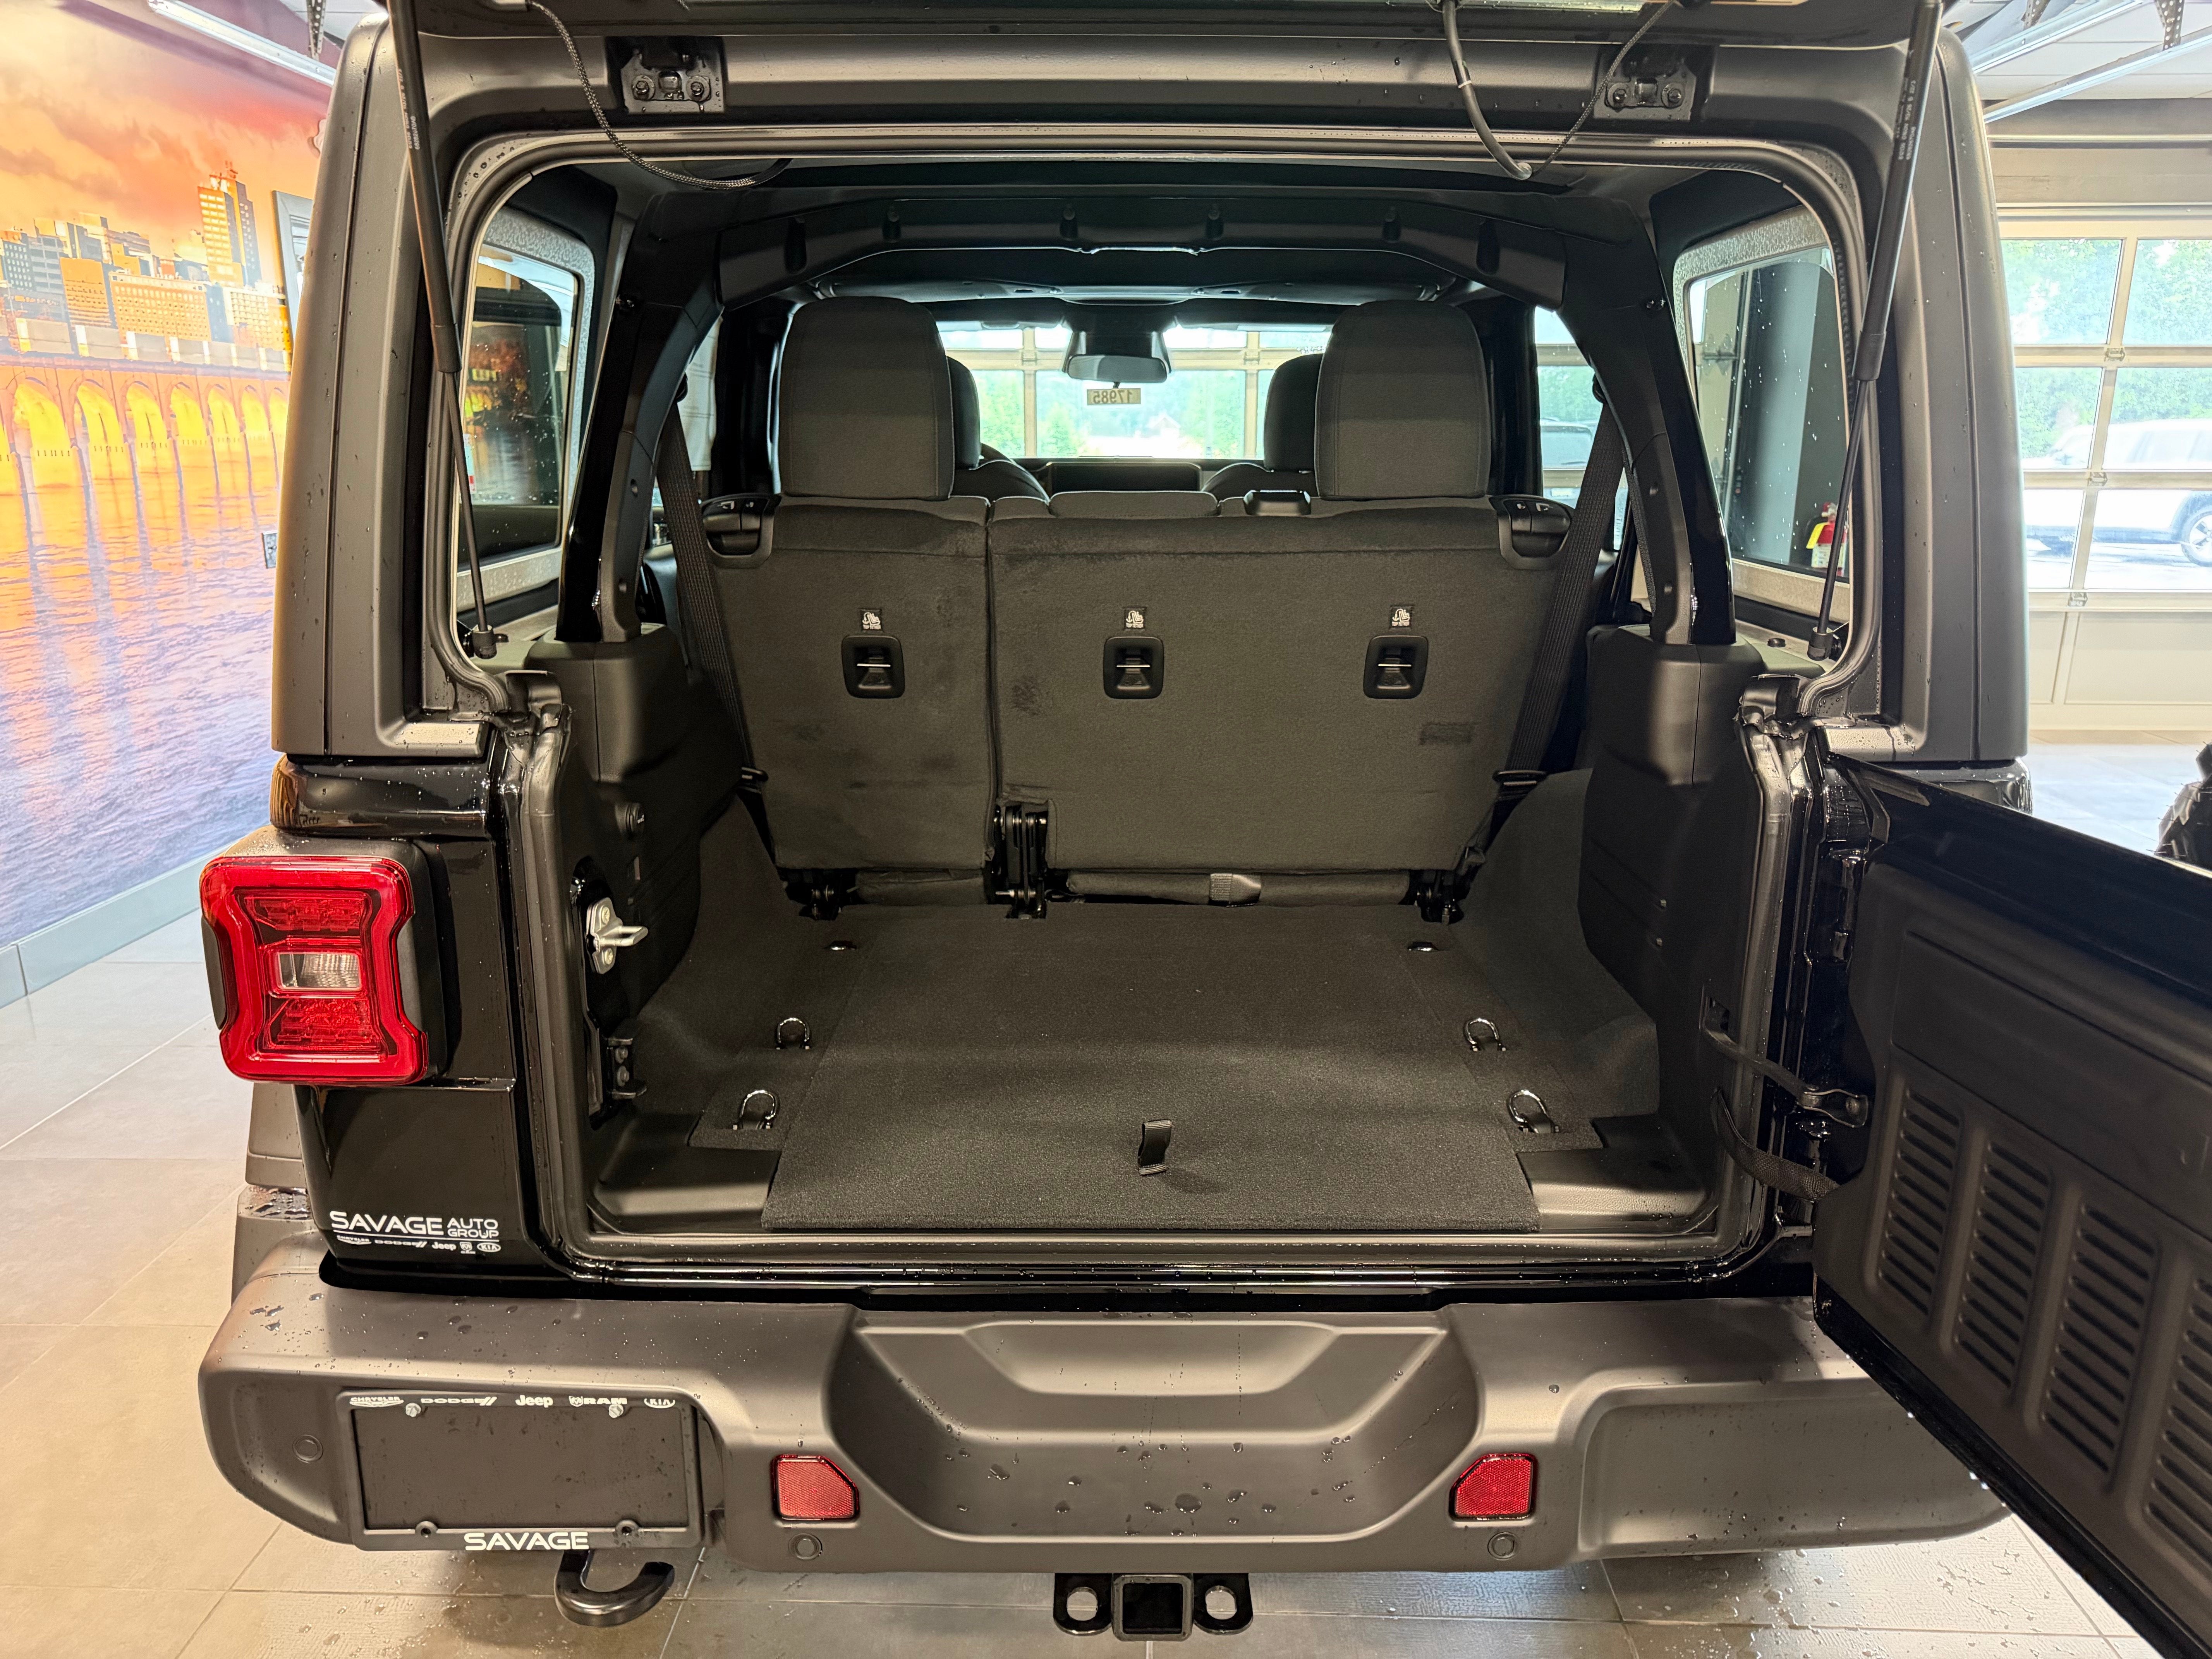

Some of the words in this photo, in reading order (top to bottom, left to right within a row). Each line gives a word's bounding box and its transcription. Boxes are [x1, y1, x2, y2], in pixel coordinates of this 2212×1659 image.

[330, 1211, 444, 1235] SAVAGE
[447, 1218, 498, 1230] AUTO
[447, 1228, 499, 1238] GROUP
[431, 1242, 457, 1251] Jeep
[515, 1395, 553, 1408] Jeep
[464, 1532, 589, 1551] SAVAGE
